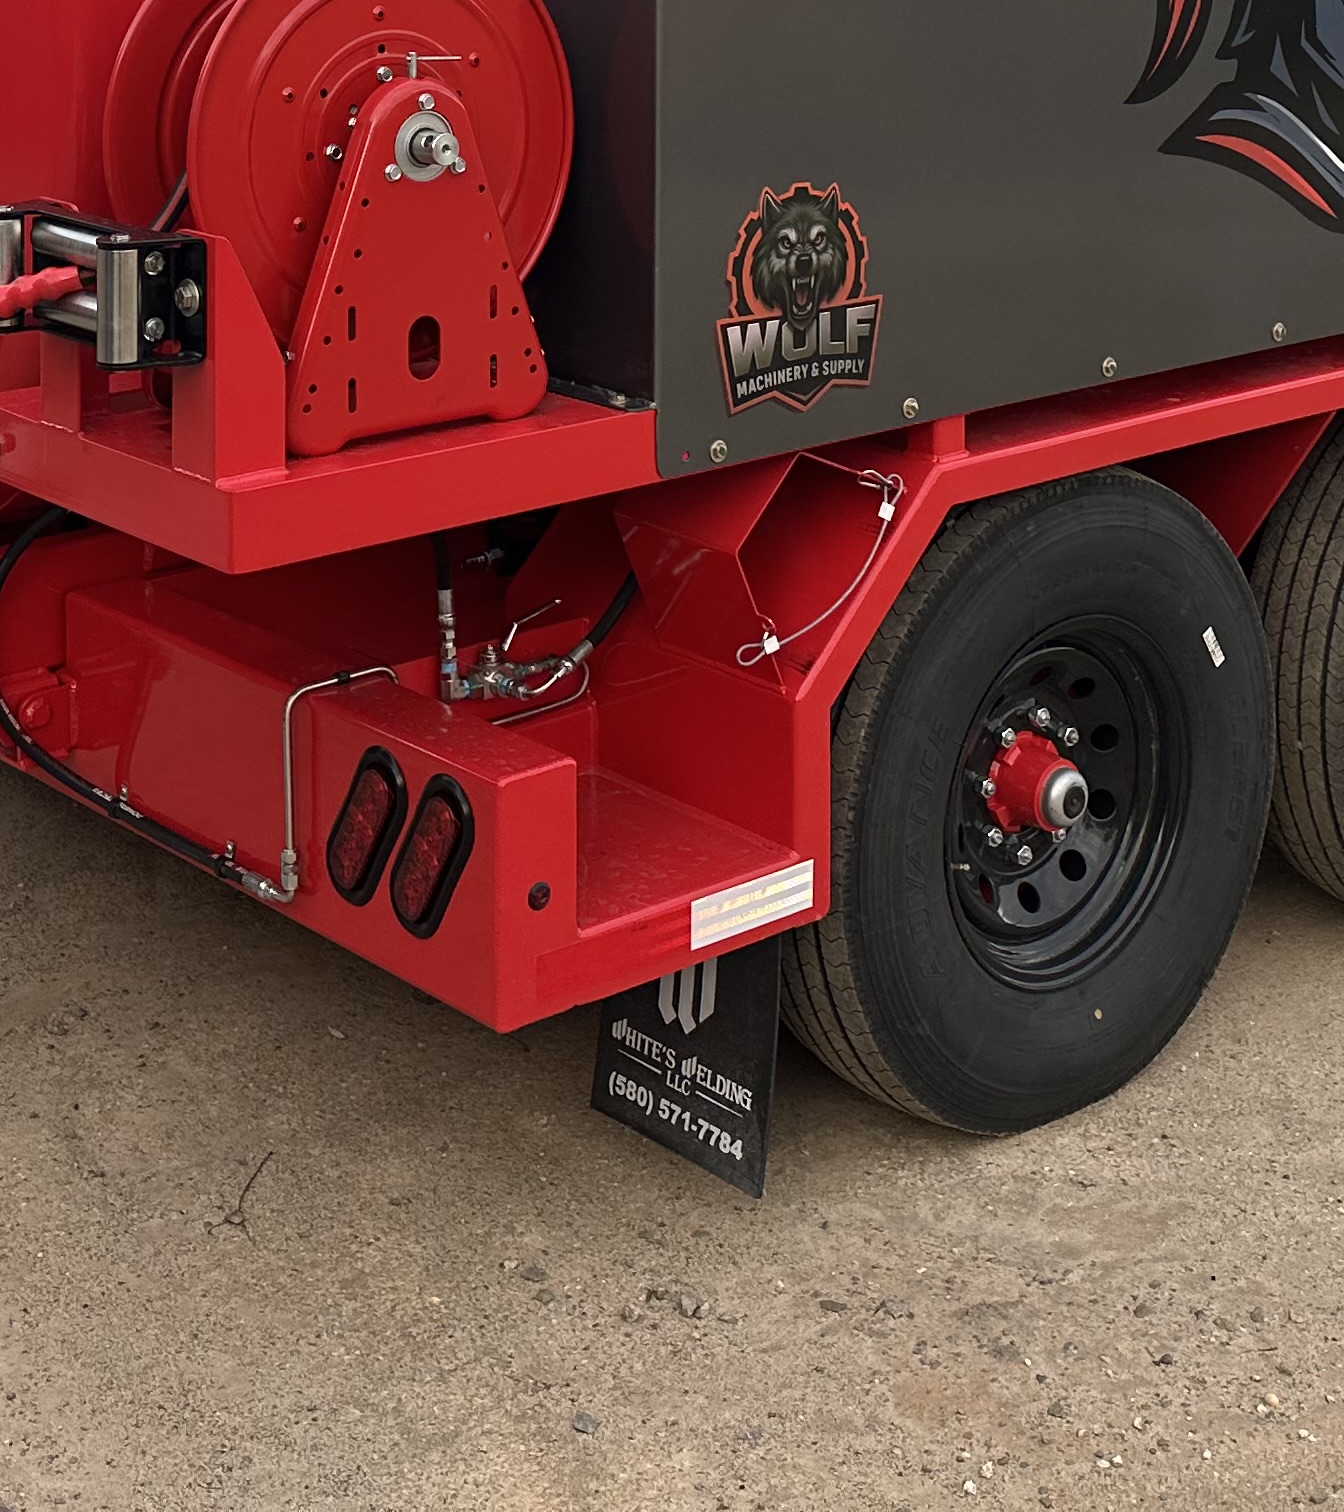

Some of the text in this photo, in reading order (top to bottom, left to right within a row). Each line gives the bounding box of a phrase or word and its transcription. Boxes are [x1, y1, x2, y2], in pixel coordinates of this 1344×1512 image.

[726, 303, 877, 378] WOLF
[736, 358, 866, 399] MACHINERY & SUPPLY
[904, 715, 950, 980] ADVANCE
[612, 1018, 752, 1111] WHITE'S WELDING
[666, 1070, 692, 1096] LLC
[608, 1071, 743, 1161] (580) 571-7784
